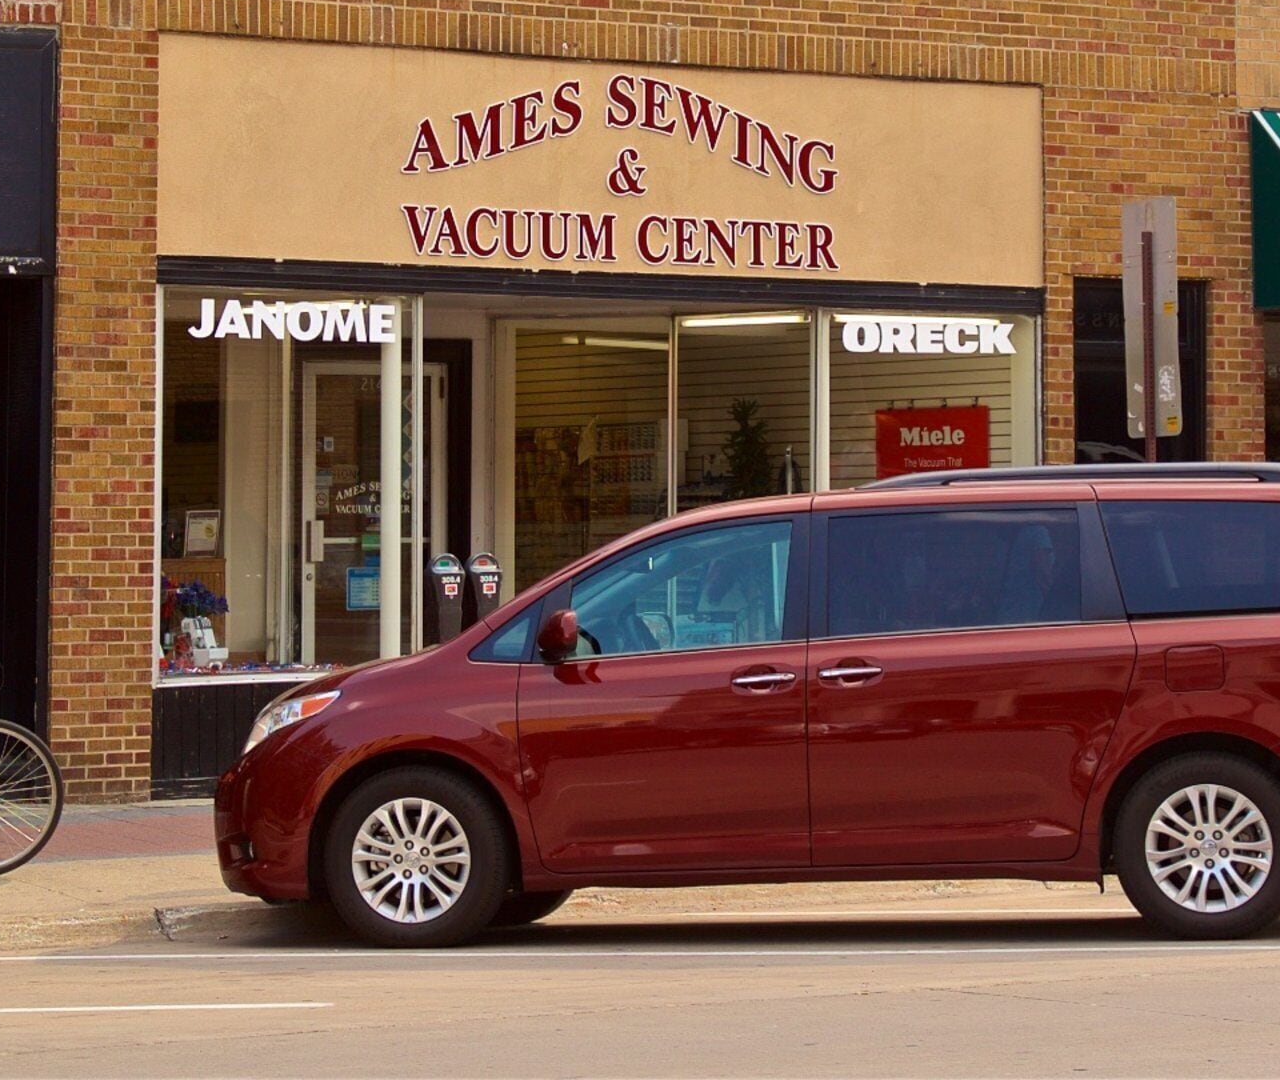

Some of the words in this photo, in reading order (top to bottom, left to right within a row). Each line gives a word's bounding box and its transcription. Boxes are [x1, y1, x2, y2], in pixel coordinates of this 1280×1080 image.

[402, 76, 583, 176] AMES
[606, 72, 838, 195] SEWING
[608, 147, 647, 197] &
[402, 204, 616, 263] VACUUM
[637, 213, 839, 272] CENTER
[187, 297, 396, 344] JANOME
[842, 321, 1017, 355] ORECK
[900, 425, 965, 447] Miele
[904, 458, 918, 468] The
[919, 457, 946, 468] Vacuum
[335, 482, 367, 500] AMES
[335, 504, 373, 514] VACUUM
